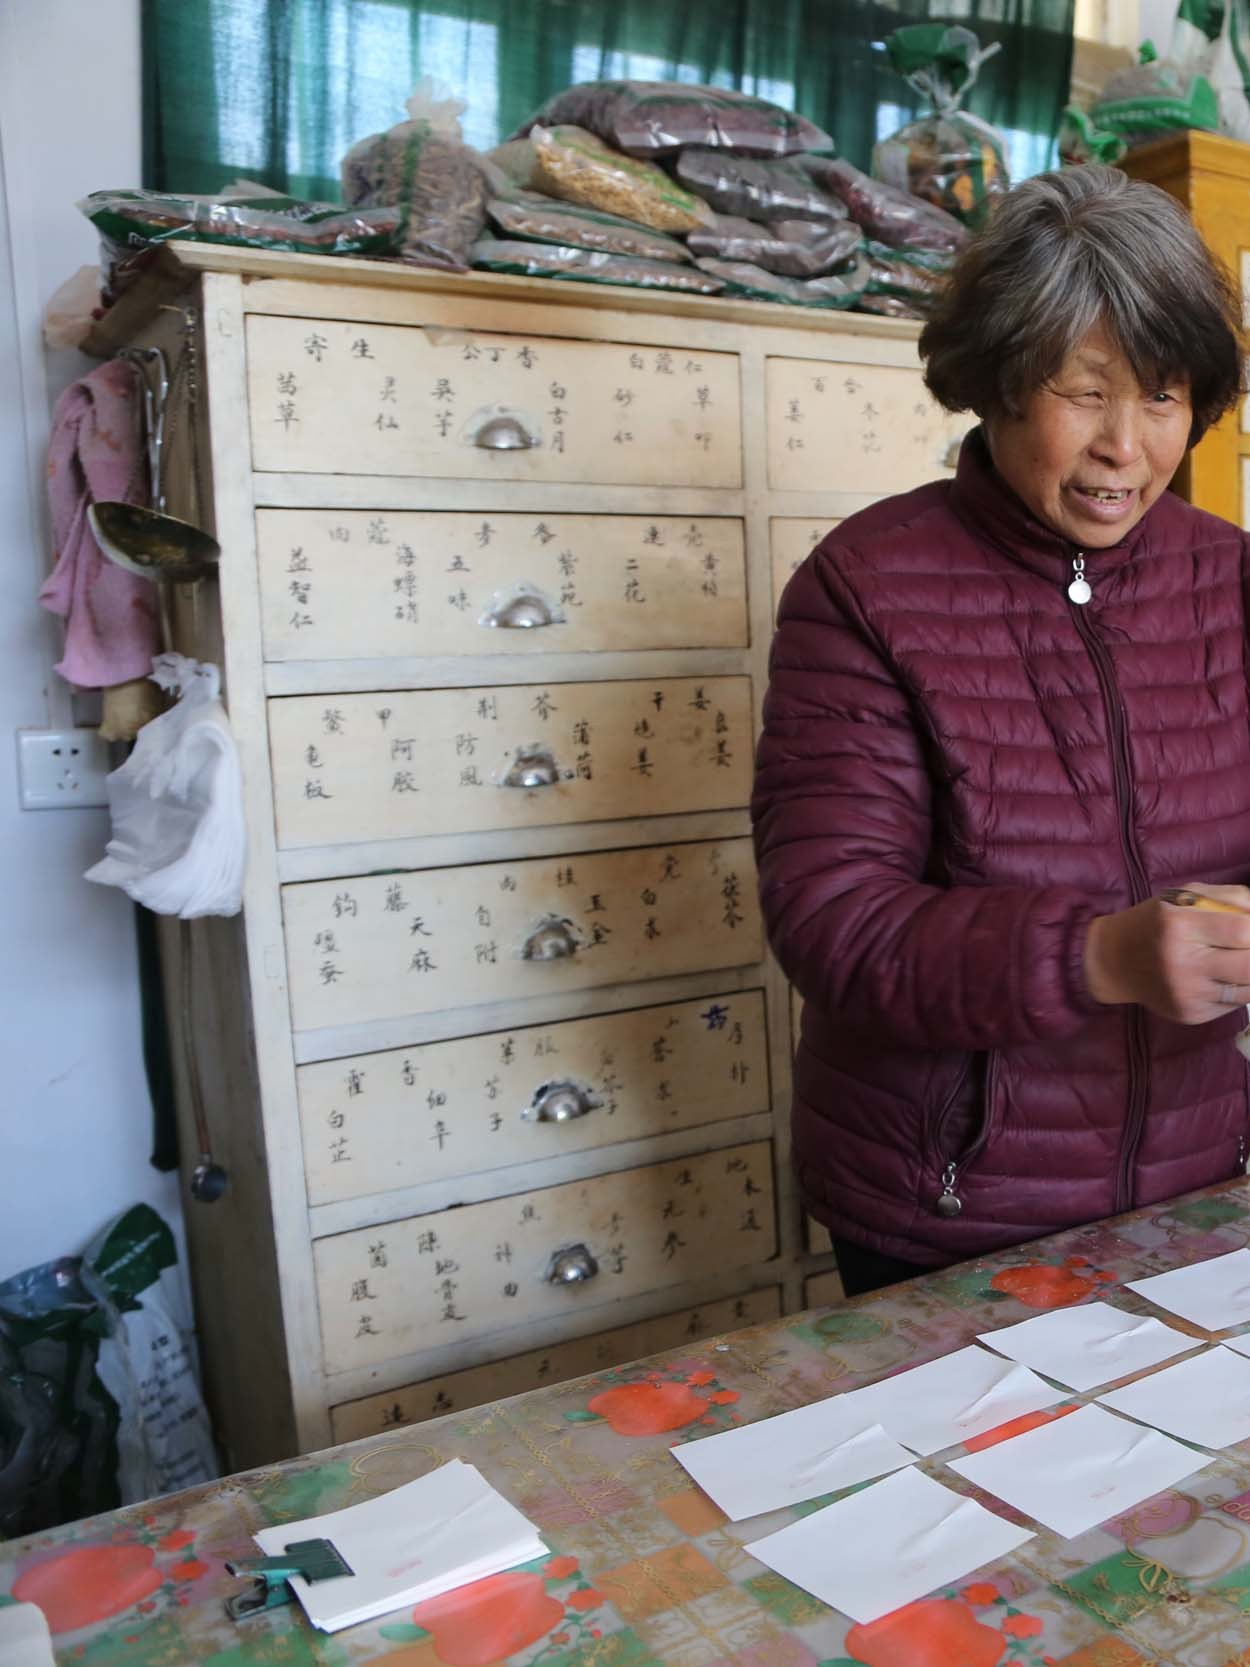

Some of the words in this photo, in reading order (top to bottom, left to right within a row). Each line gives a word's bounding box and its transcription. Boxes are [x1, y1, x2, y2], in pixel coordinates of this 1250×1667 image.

[304, 333, 376, 362] 寄生
[462, 343, 539, 370] 公丁香
[611, 388, 634, 443] 砂仁
[285, 546, 314, 630] 益智仁
[445, 555, 471, 612] 五味
[624, 559, 646, 604] 二花
[651, 688, 711, 712] 干姜
[407, 916, 438, 974] 天麻
[327, 1110, 352, 1164] 白芷
